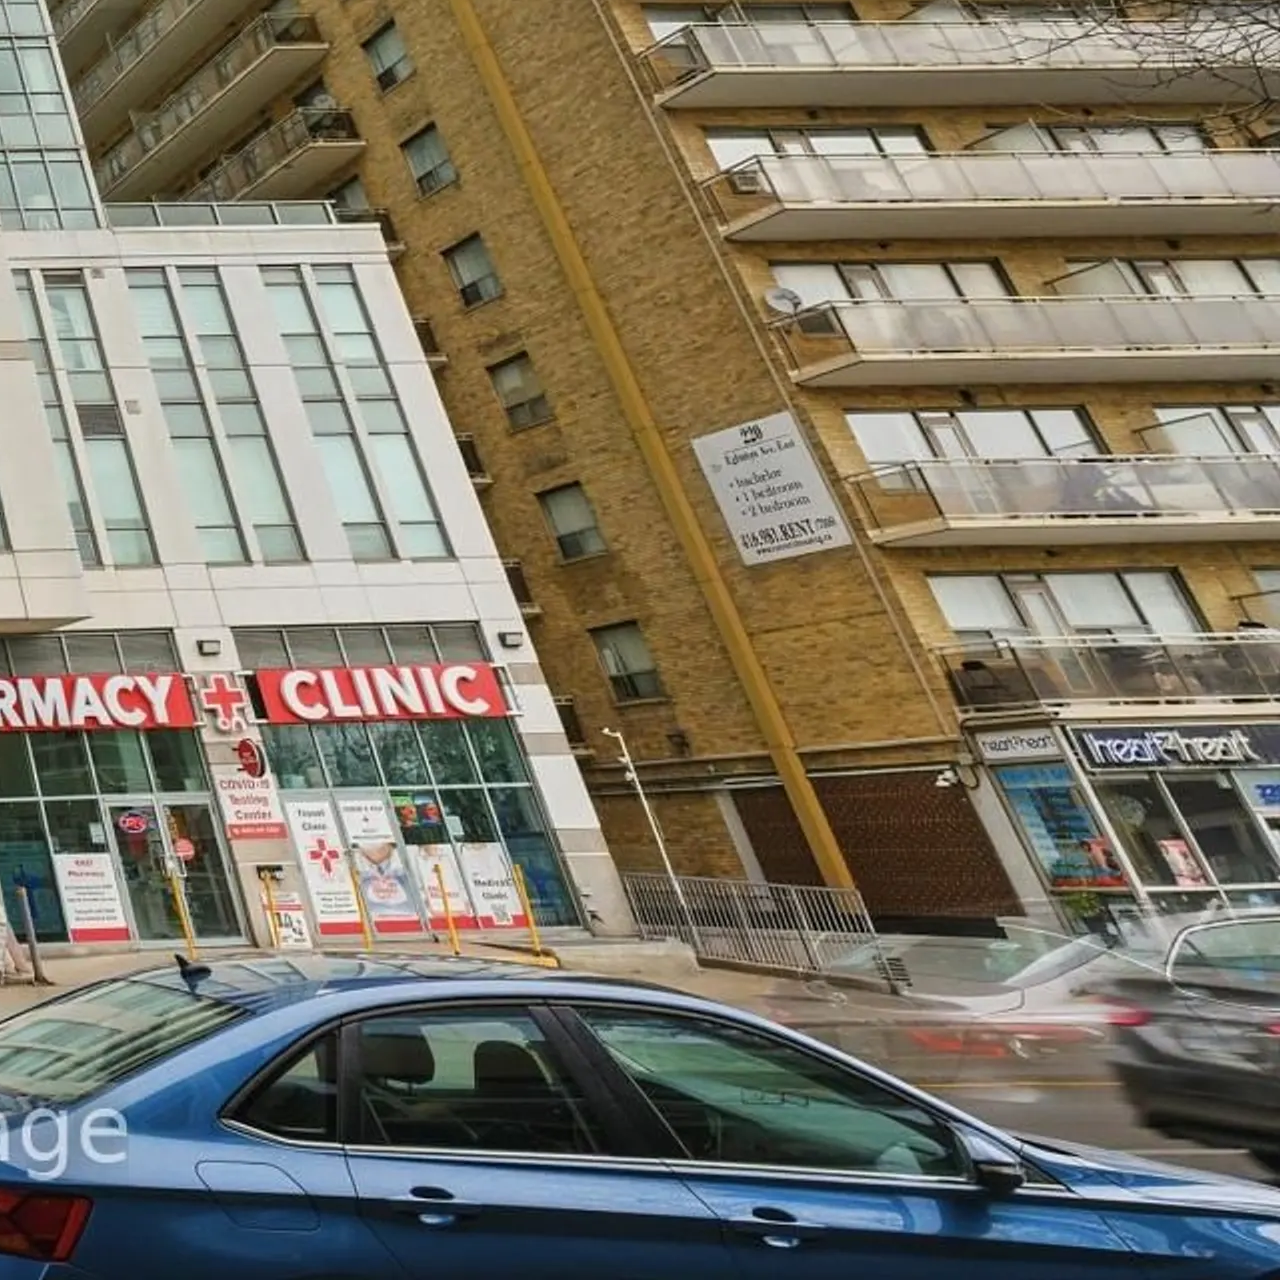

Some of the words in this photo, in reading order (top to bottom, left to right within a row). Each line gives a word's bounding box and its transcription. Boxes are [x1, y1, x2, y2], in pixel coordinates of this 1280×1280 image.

[751, 481, 803, 501] bedroom
[760, 495, 811, 515] bedroom
[281, 666, 490, 719] CLINIC
